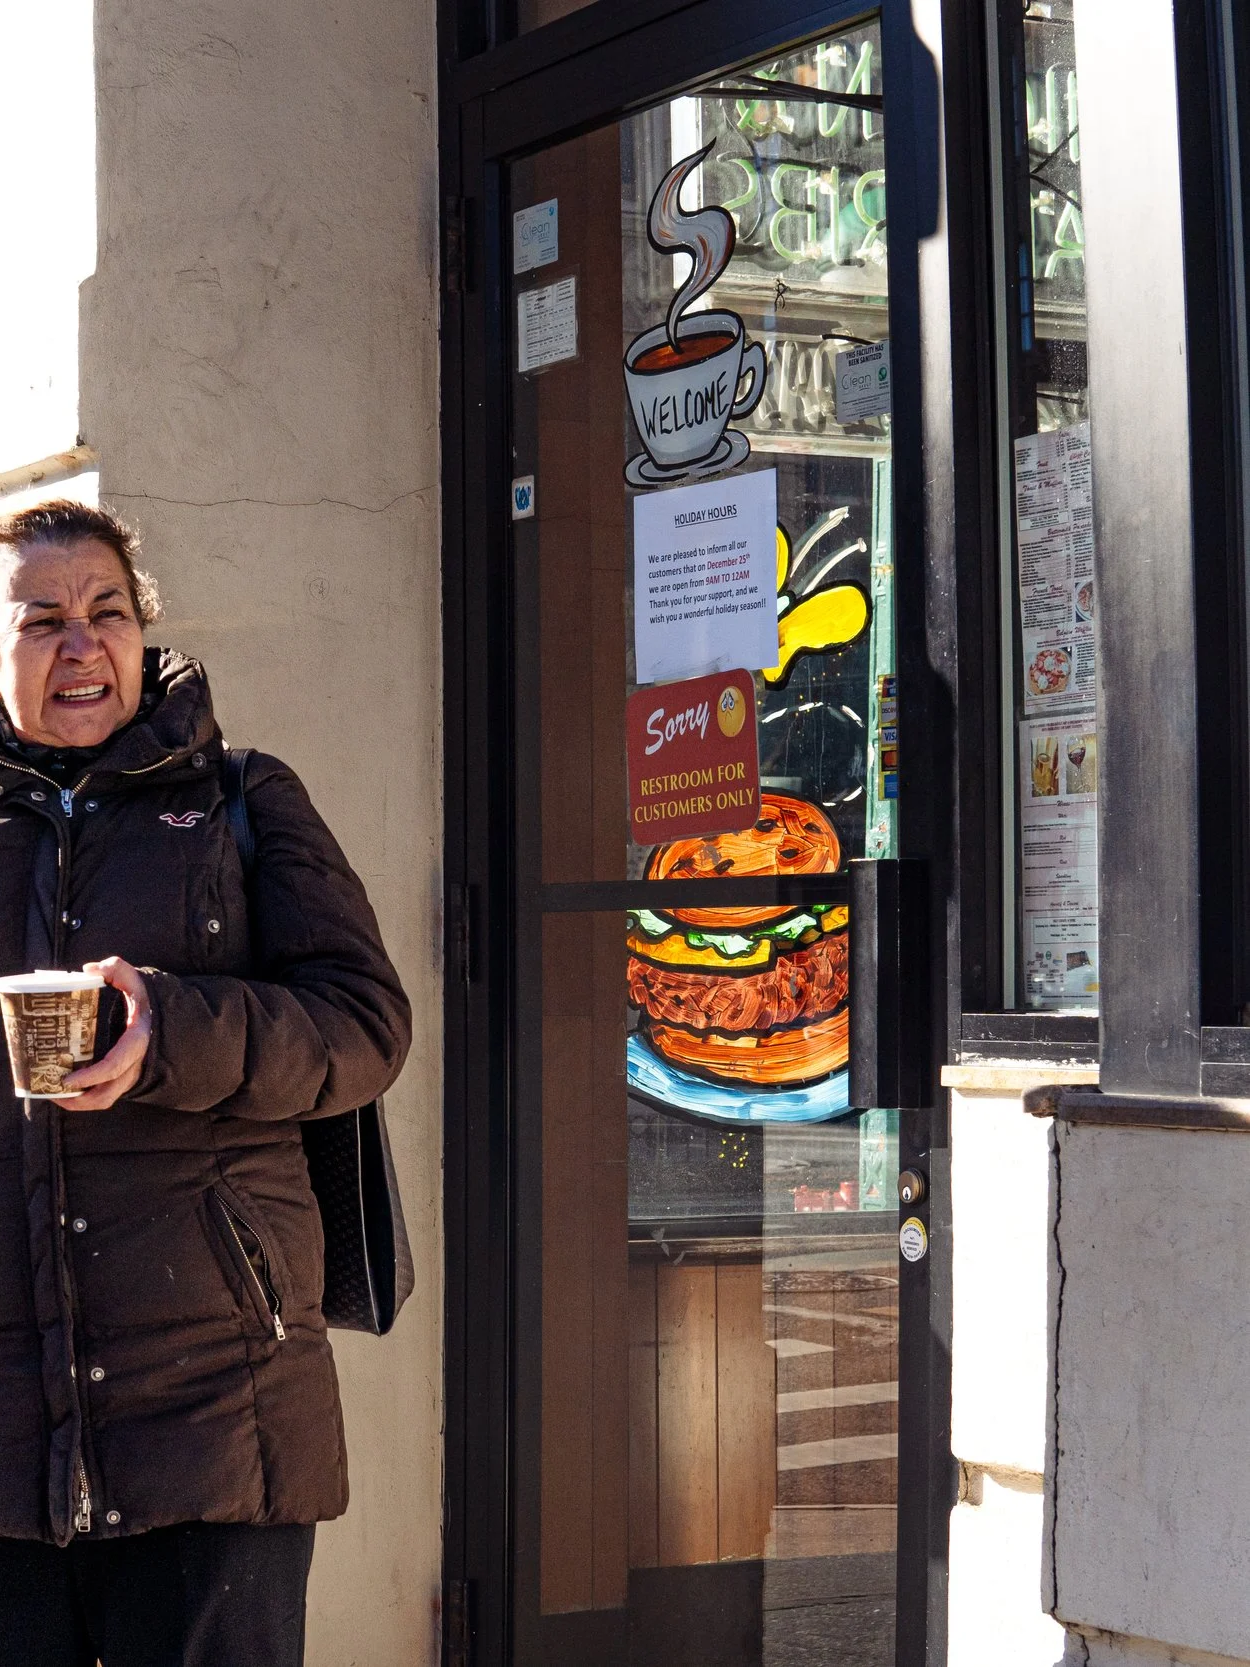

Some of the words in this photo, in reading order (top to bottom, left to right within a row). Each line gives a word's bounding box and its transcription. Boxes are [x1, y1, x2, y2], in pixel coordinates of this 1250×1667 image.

[846, 351, 856, 360] THIS
[856, 346, 875, 357] FACILITY
[875, 343, 884, 352] HAS
[848, 358, 860, 367] BEEN
[860, 352, 883, 364] SANITIZED
[842, 373, 872, 391] Clean
[640, 371, 729, 440] WELCOME
[674, 509, 706, 526] HOLIDAY
[707, 504, 737, 520] HOURS
[648, 554, 659, 564] We
[661, 554, 672, 562] are
[673, 548, 697, 562] pleased
[698, 547, 706, 556] to
[706, 544, 728, 554] inform
[728, 541, 736, 551] all
[737, 541, 747, 549] our
[648, 567, 682, 579] customers
[683, 564, 696, 574] that
[707, 557, 738, 570] December
[739, 553, 750, 564] 25th
[649, 586, 659, 594] we
[660, 584, 671, 592] are
[672, 582, 689, 592] open
[689, 578, 704, 588] from
[705, 575, 720, 586] 9AM
[722, 573, 731, 583] TO
[732, 570, 750, 581] 12AM
[649, 597, 669, 609] Thank
[670, 598, 682, 608] you
[683, 595, 693, 604] for
[693, 594, 707, 605] your
[708, 589, 734, 601] support,
[735, 585, 747, 596] and
[748, 585, 759, 594] we
[649, 613, 665, 624] wish
[666, 613, 678, 624] you
[683, 605, 714, 619] wonderful
[715, 603, 739, 614] holiday
[740, 598, 766, 611] season!!
[645, 701, 710, 756] Sorry
[884, 731, 897, 741] VIS
[641, 768, 713, 796] RESTROOM
[718, 762, 745, 783] FOR
[634, 795, 712, 823] CUSTOMERS
[716, 788, 754, 810] ONLY
